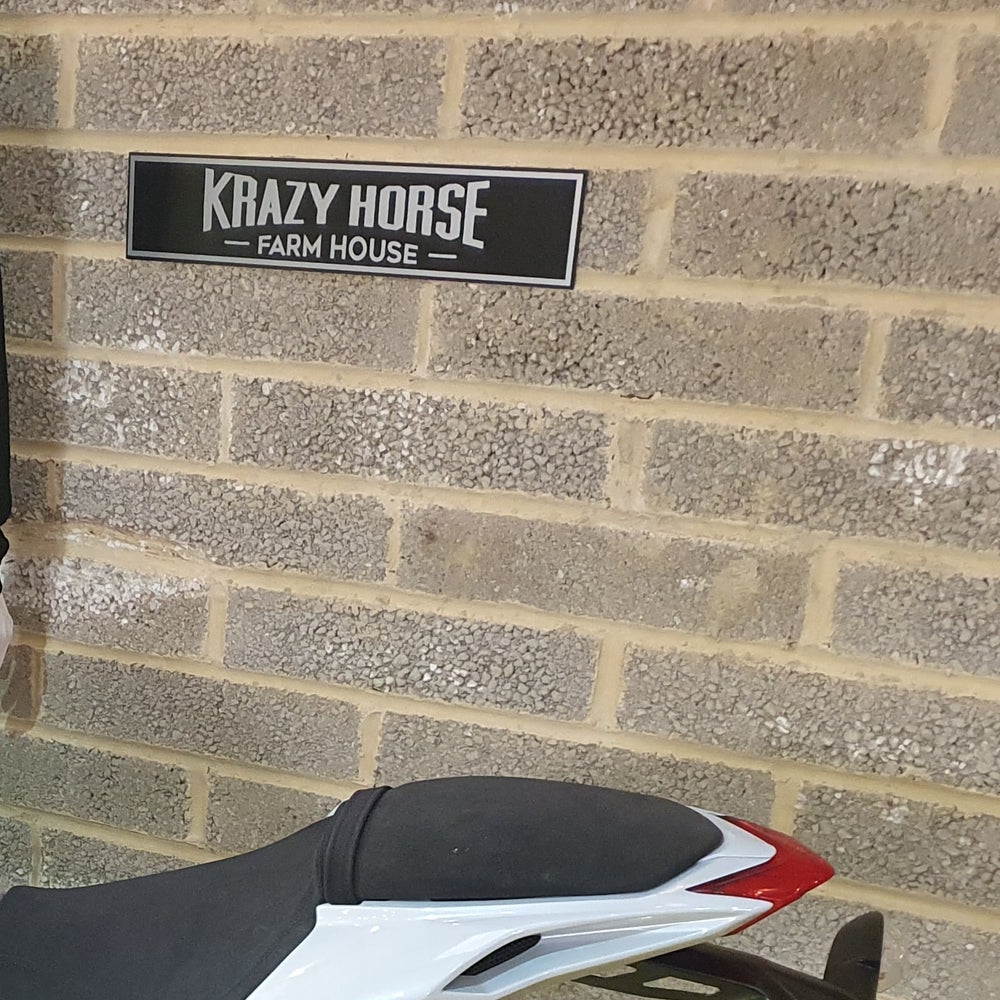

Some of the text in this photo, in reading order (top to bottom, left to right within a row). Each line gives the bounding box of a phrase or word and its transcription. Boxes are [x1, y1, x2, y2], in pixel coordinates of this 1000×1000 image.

[203, 167, 490, 249] KRAZY HORSE
[257, 233, 418, 265] FARM HOUSE
